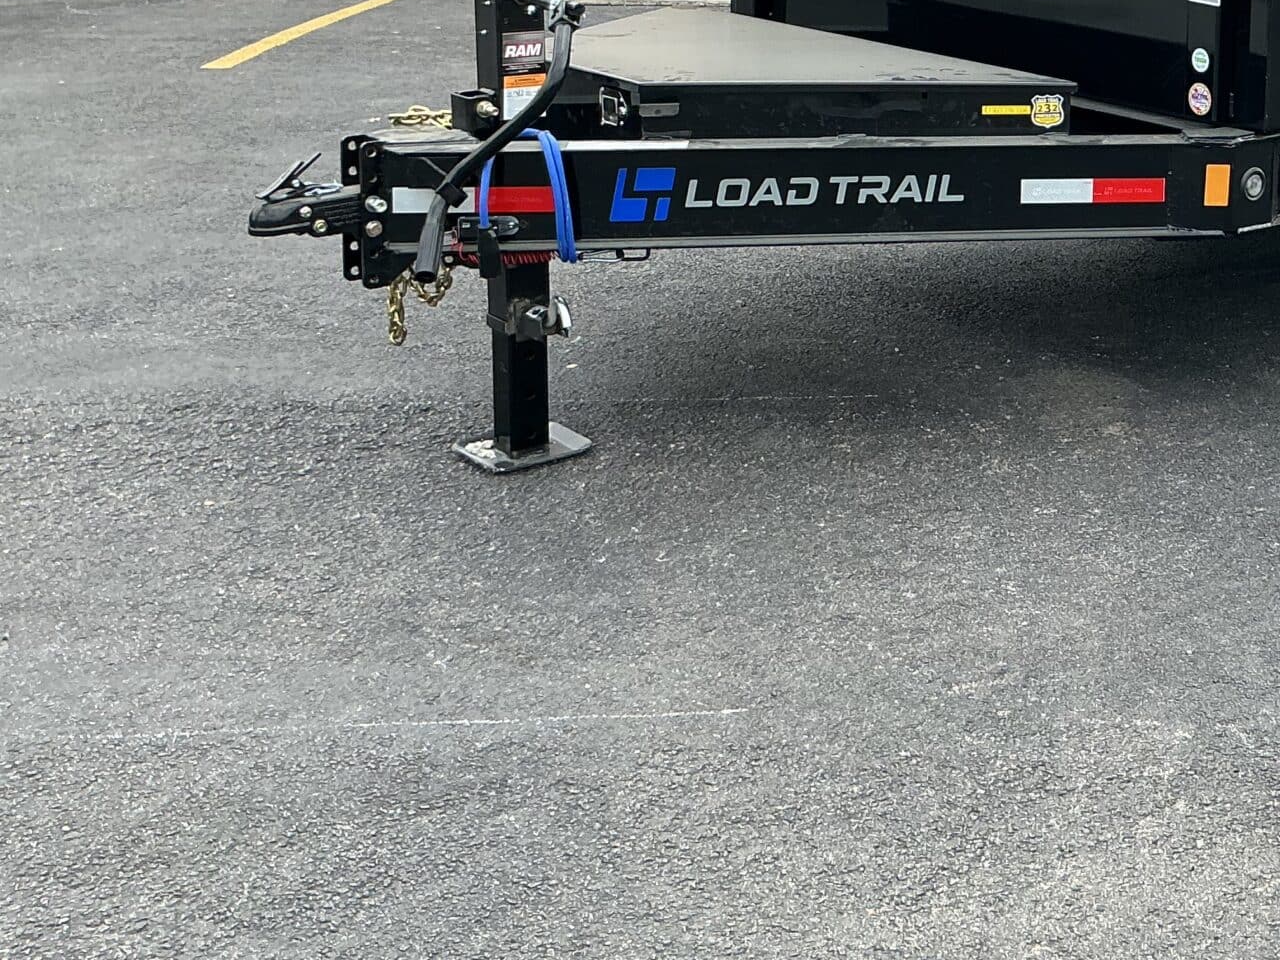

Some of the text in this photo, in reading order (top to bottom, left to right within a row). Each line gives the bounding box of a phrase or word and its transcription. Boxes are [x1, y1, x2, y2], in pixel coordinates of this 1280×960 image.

[504, 43, 541, 58] RAM
[1037, 103, 1058, 113] 232
[684, 174, 965, 208] LOAD TRAIL
